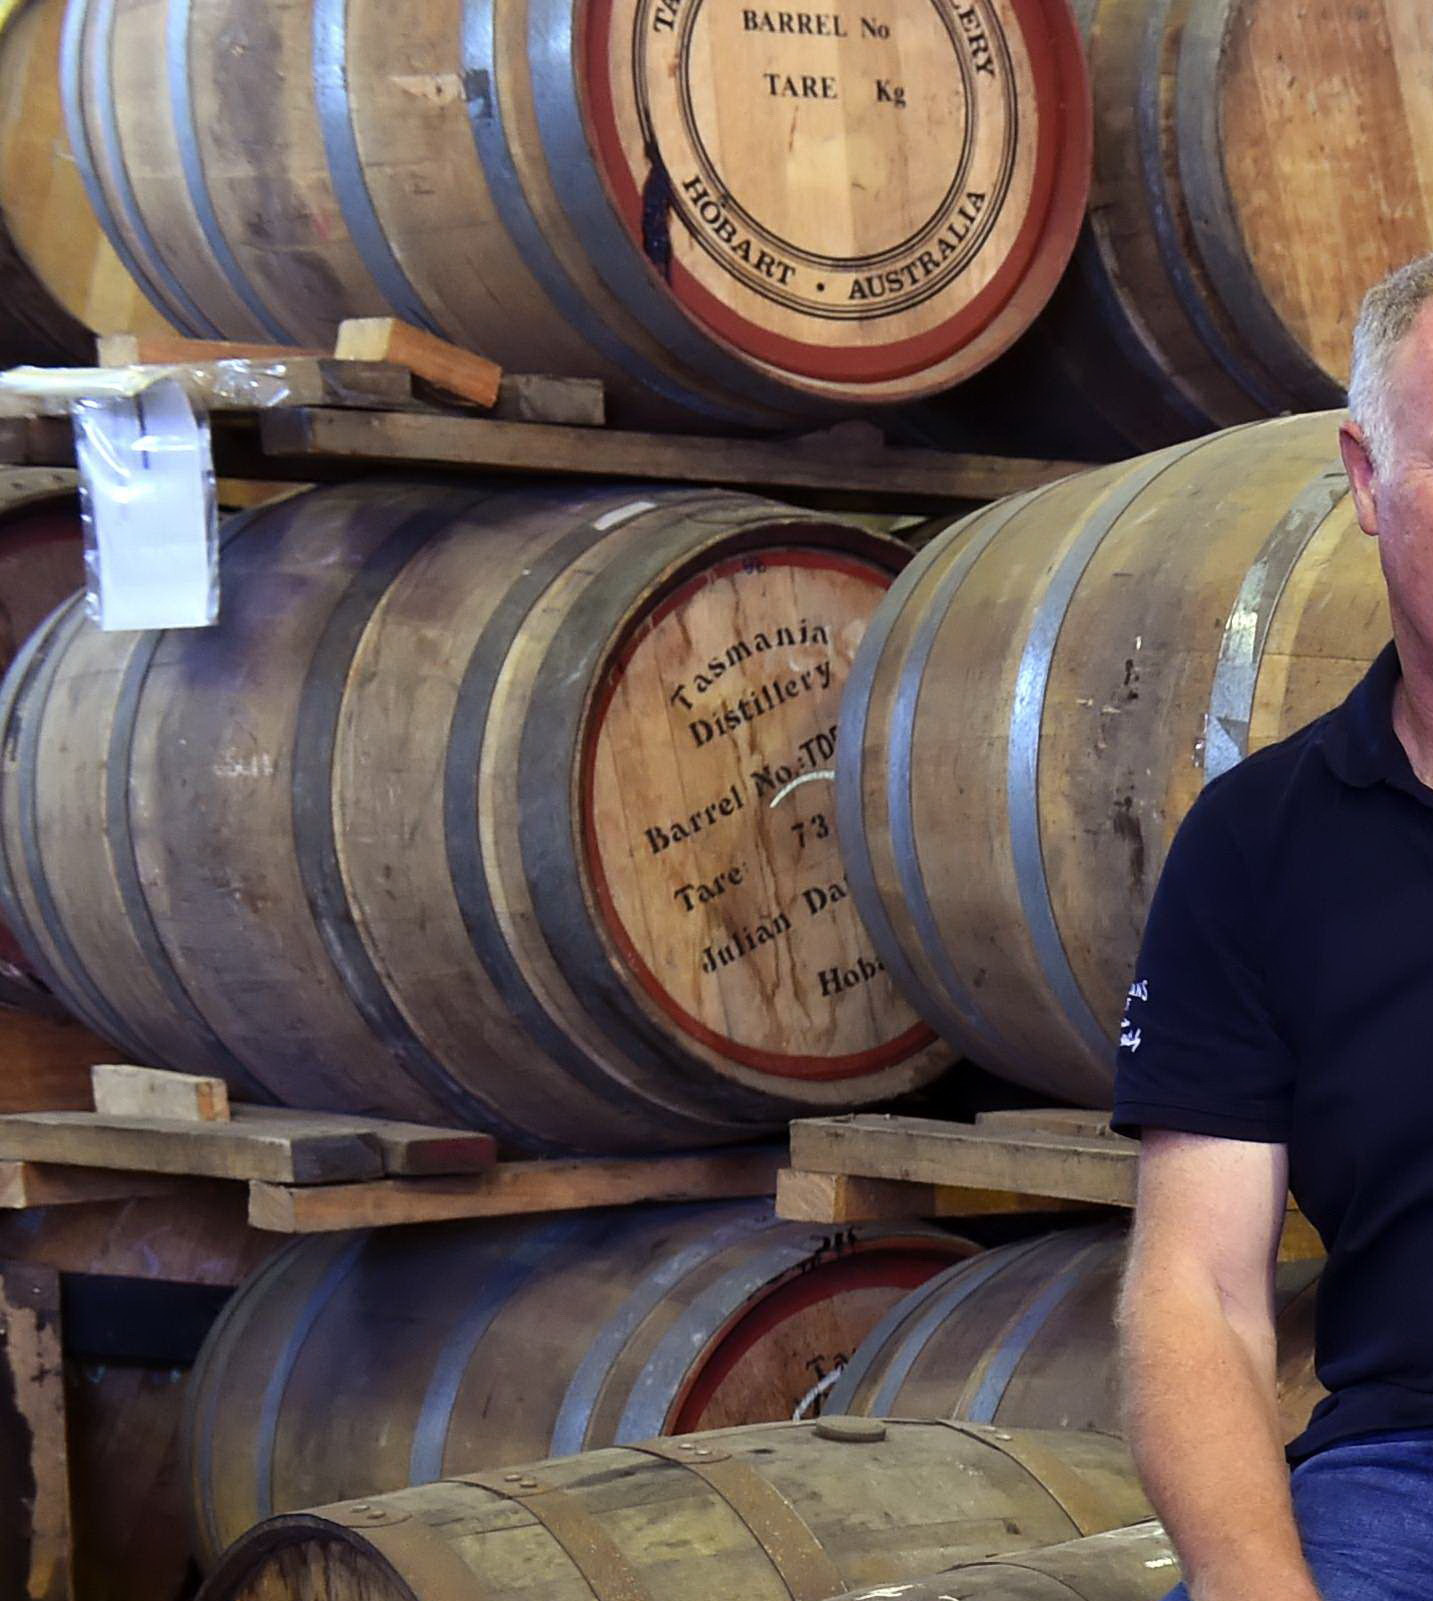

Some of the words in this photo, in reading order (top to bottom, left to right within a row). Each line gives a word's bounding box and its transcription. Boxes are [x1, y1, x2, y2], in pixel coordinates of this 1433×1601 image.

[743, 10, 848, 38] BARREL
[860, 18, 891, 40] No
[763, 73, 838, 99] TARE
[876, 79, 906, 107] Kg
[681, 174, 796, 287] HOBART
[848, 189, 987, 301] AUSTRALIA
[670, 617, 829, 713] Tasmania
[689, 660, 832, 748] Distillery
[643, 784, 744, 856] Barrel
[702, 911, 791, 974] Julian
[802, 872, 848, 915] Da
